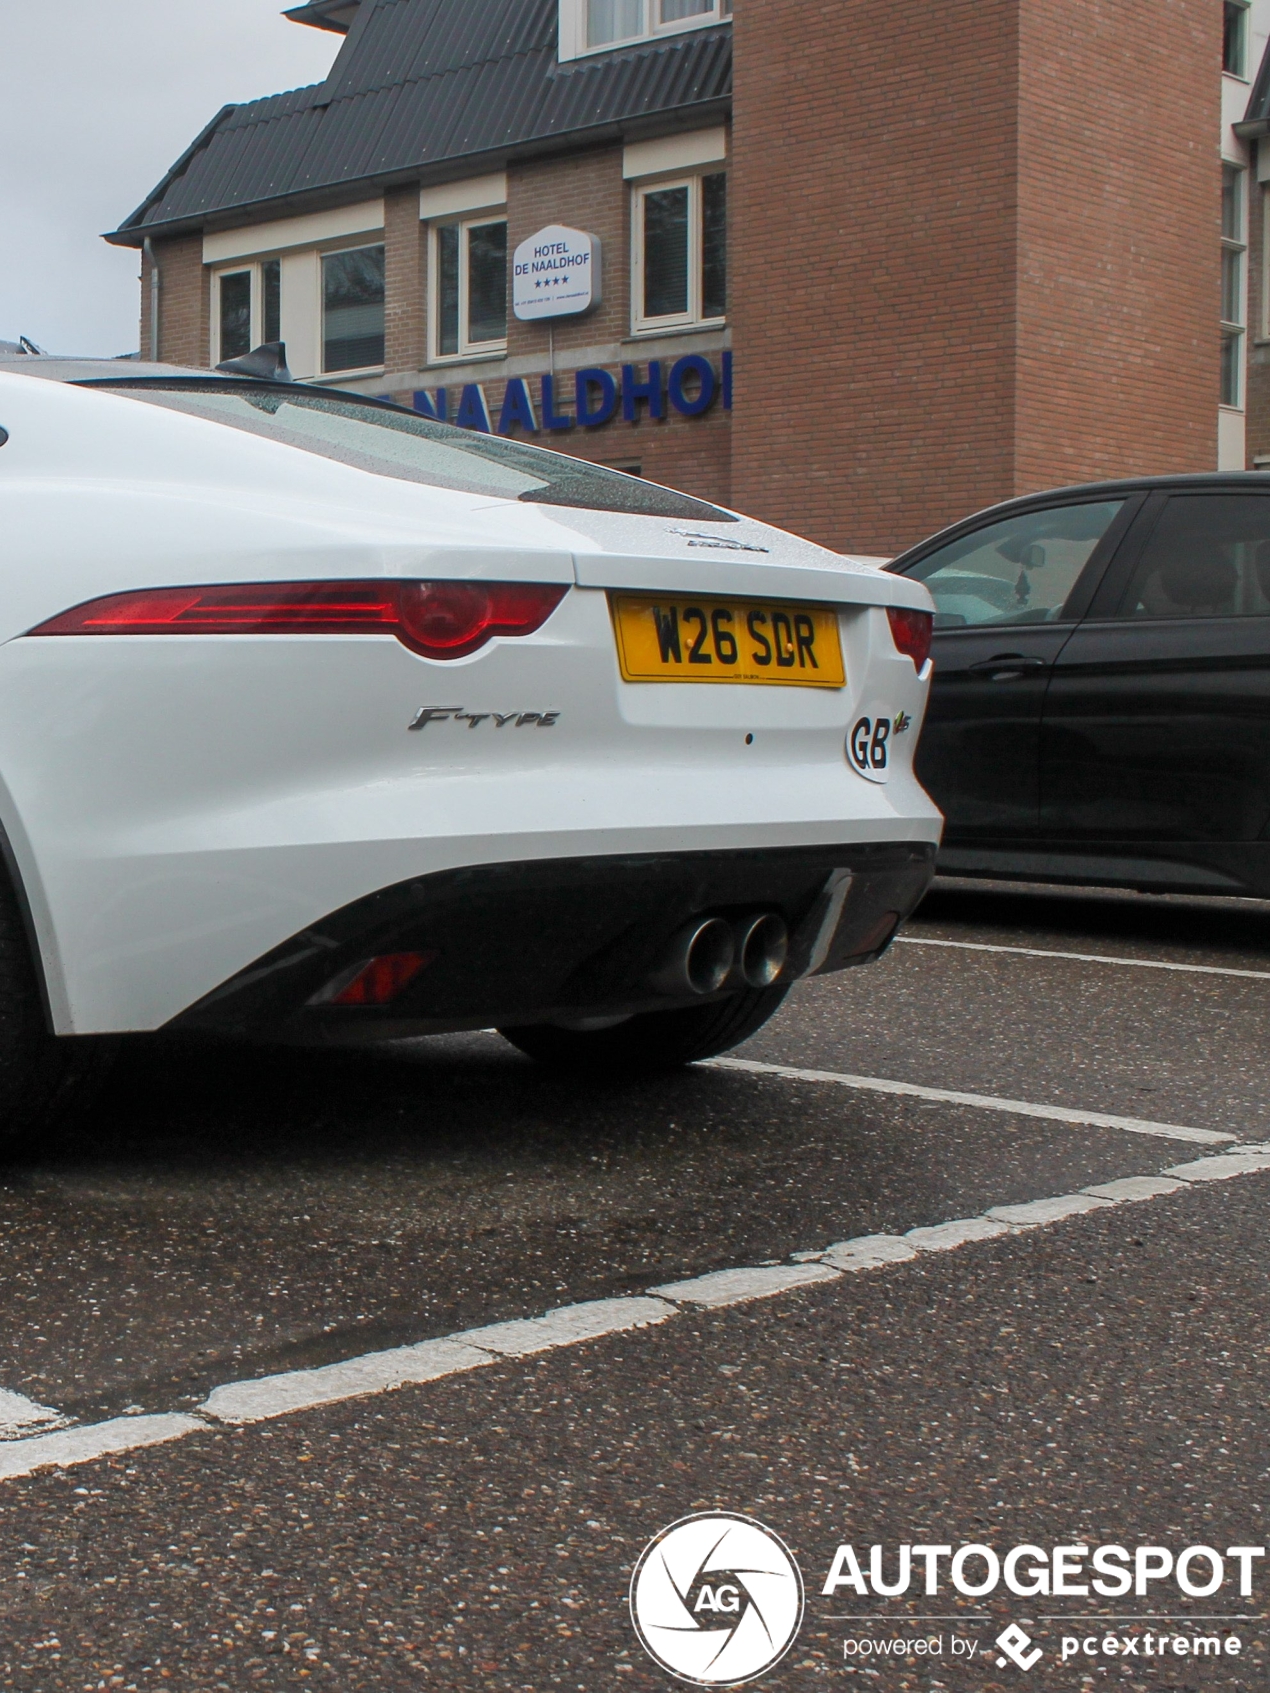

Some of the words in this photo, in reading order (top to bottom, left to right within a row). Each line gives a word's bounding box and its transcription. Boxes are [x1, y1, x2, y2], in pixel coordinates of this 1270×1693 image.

[534, 242, 569, 258] HOTEL
[515, 263, 529, 276] DE
[531, 253, 590, 273] NAALDHOF
[652, 606, 738, 665] W26
[746, 610, 819, 669] SDR
[408, 705, 561, 730] F-TYPE
[850, 716, 890, 770] GB
